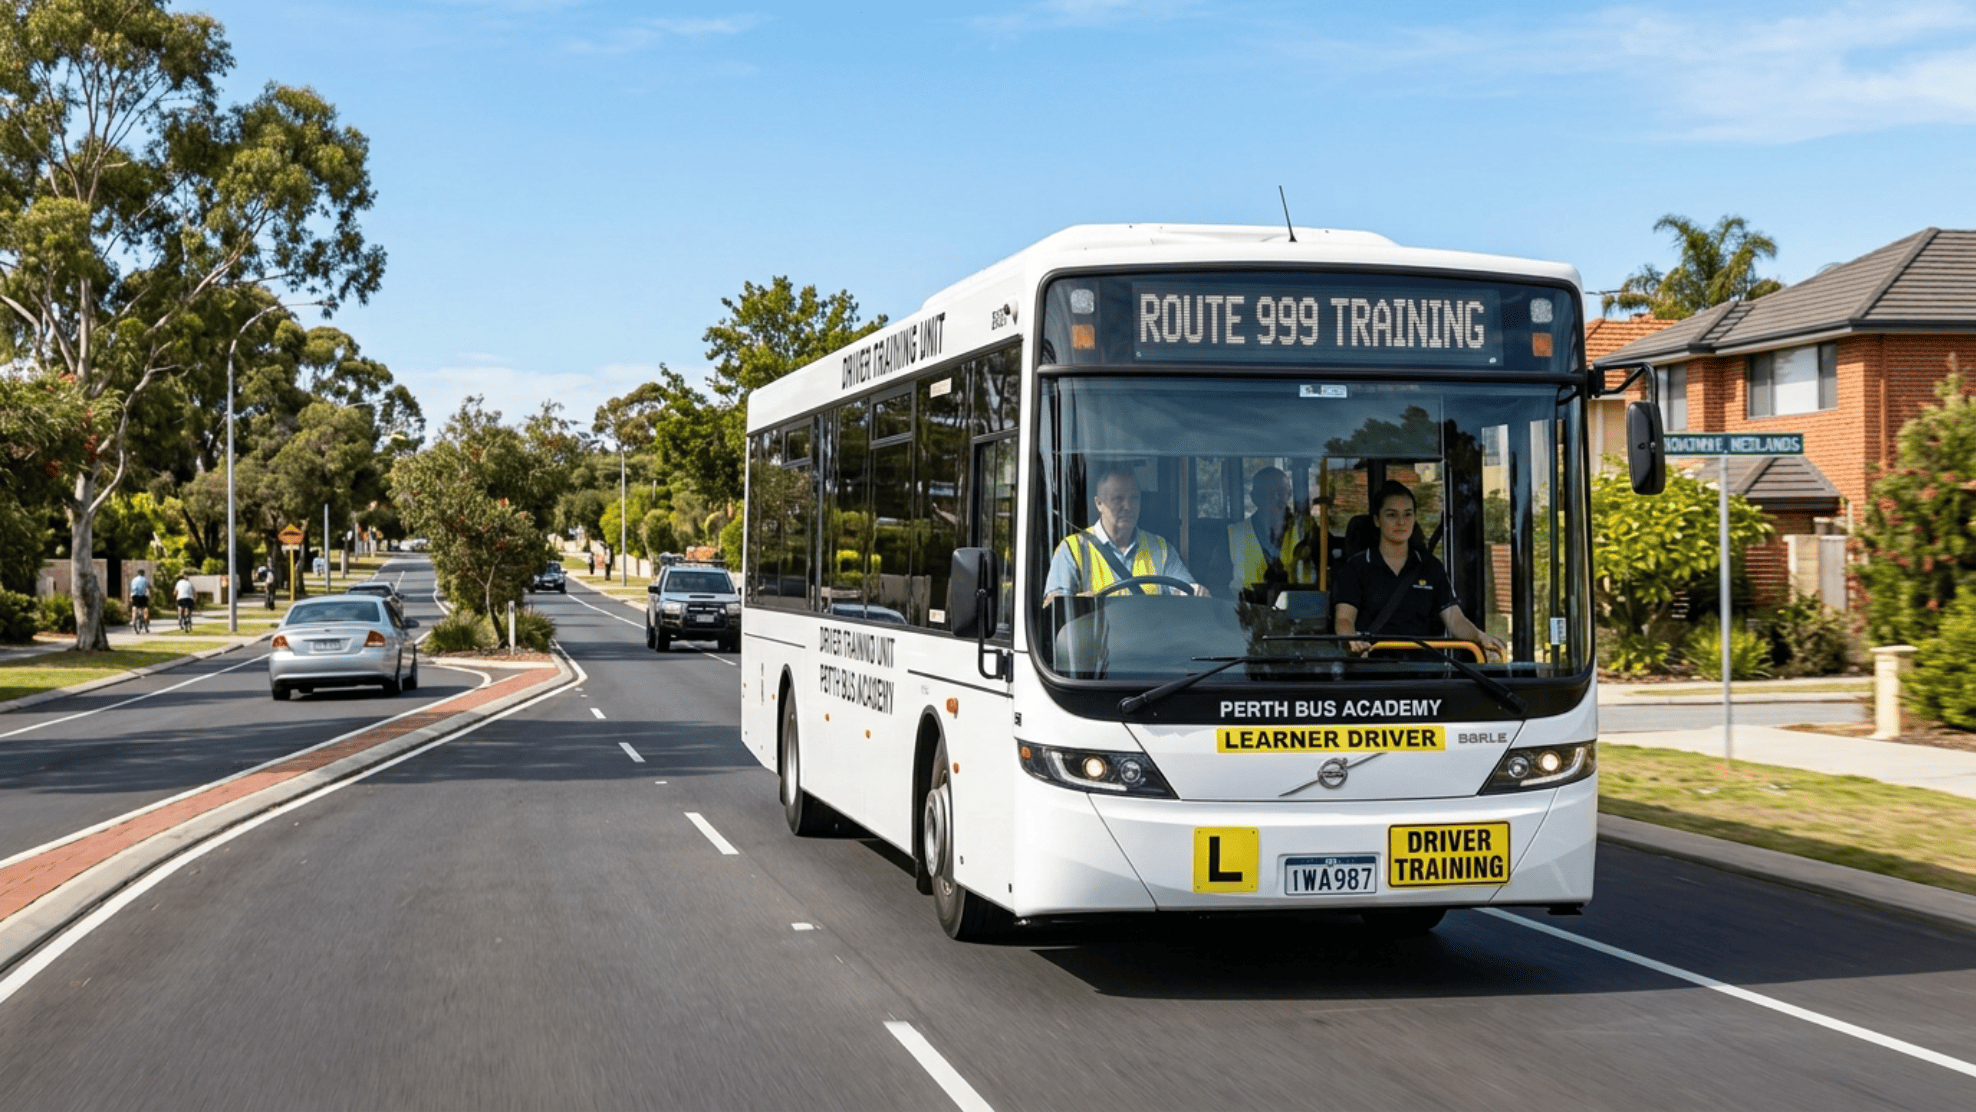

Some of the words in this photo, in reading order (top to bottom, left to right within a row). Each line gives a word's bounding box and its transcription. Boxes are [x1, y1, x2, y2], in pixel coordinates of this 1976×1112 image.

[1140, 293, 1245, 344] ROUTE
[1256, 296, 1319, 346] 999
[1330, 298, 1485, 349] TRAINING
[1220, 701, 1289, 718] PERTH
[1294, 700, 1337, 717] BUS
[1341, 699, 1443, 717] ACADEMY
[1225, 731, 1341, 750] LEARNER
[1347, 729, 1437, 748] DRIVER
[1407, 829, 1492, 854] DRIVER
[1208, 836, 1243, 882] L
[1394, 854, 1504, 881] TRAINING
